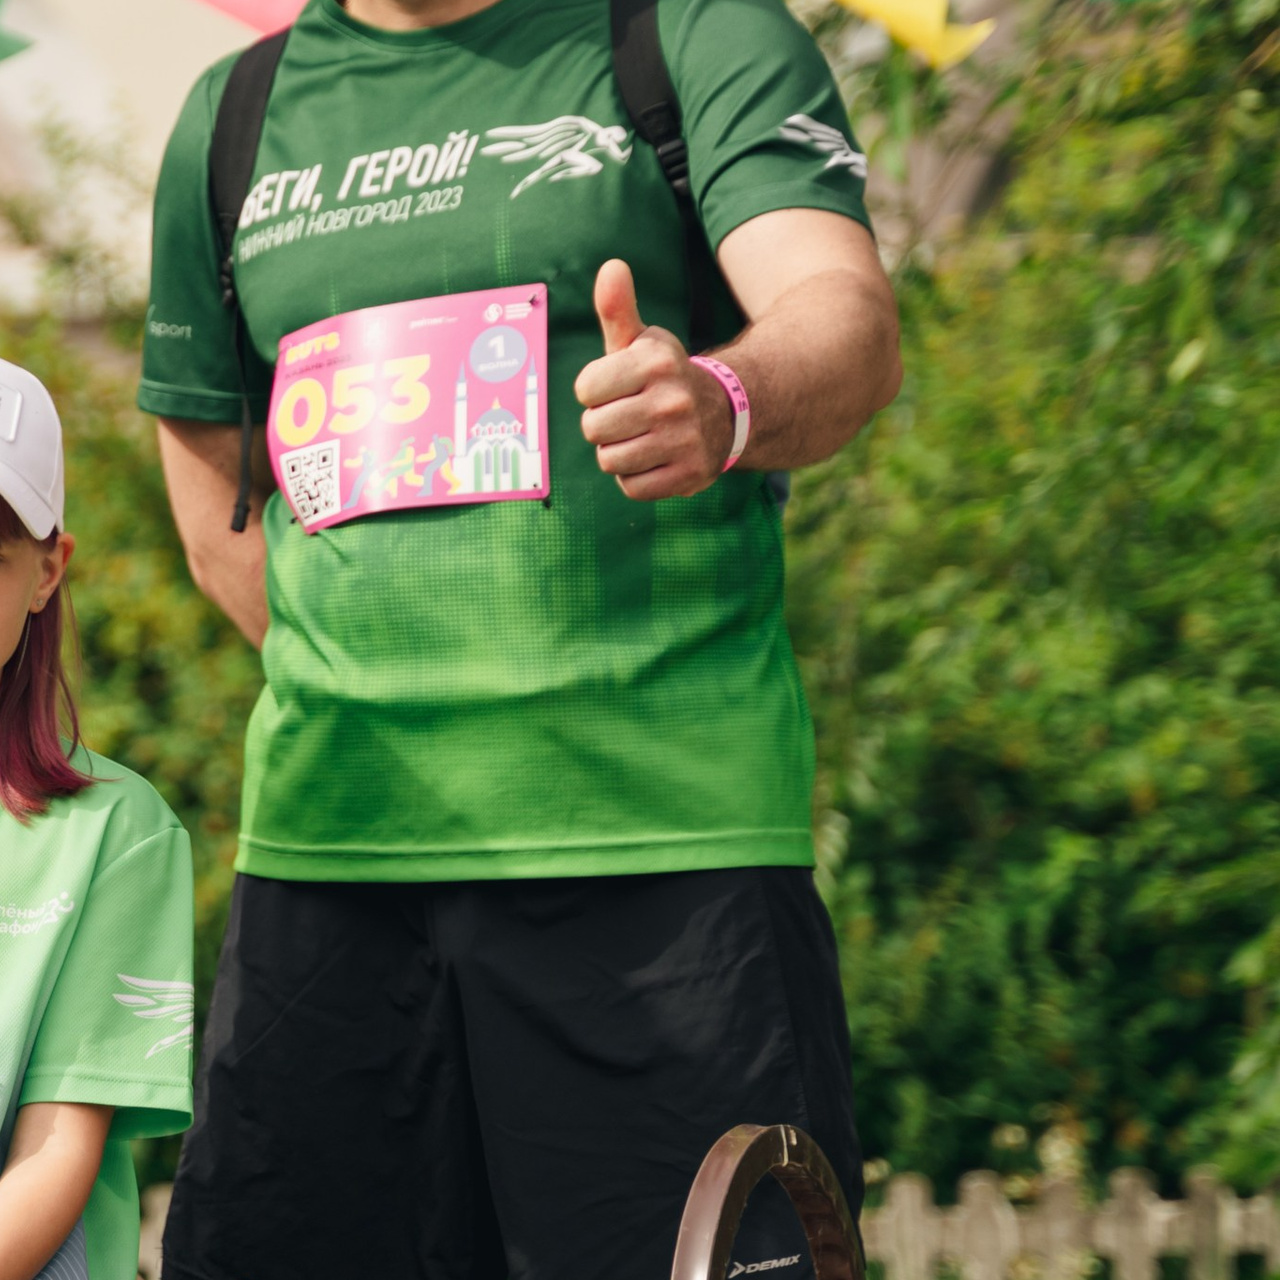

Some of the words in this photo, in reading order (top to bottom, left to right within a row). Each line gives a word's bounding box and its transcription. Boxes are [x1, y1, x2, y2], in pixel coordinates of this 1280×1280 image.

[336, 129, 480, 201] ГЕРОЙ!
[305, 194, 413, 236] НОВГОРОД
[414, 185, 464, 216] 2023
[487, 334, 506, 359] 1
[275, 353, 431, 447] 053
[745, 1254, 801, 1274] DEMIX
